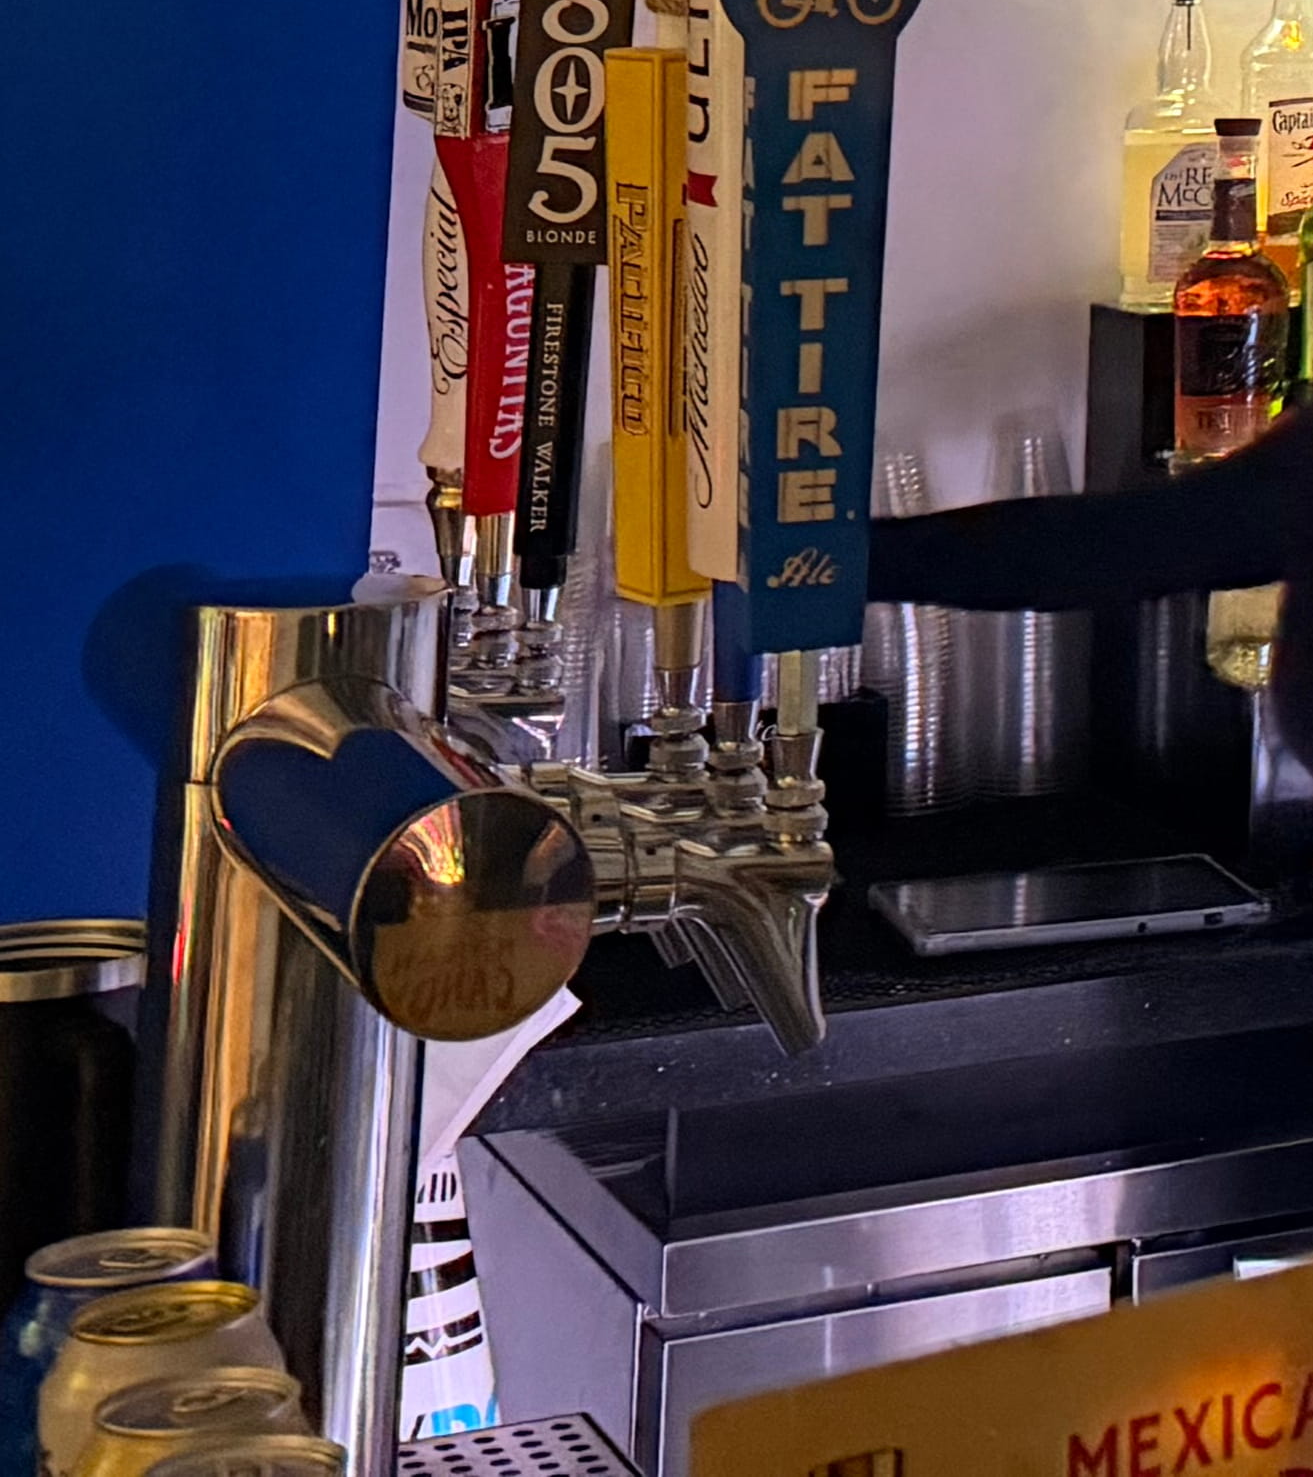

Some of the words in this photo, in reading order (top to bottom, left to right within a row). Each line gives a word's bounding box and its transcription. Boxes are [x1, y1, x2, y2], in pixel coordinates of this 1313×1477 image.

[780, 68, 858, 247] FAT
[1157, 182, 1215, 207] McC
[1185, 166, 1213, 186] RE
[526, 229, 597, 245] BLONDE
[431, 187, 467, 396] Especial
[537, 302, 564, 427] FIRESTONE
[776, 277, 849, 523] TIRE
[530, 442, 553, 534] WALKER
